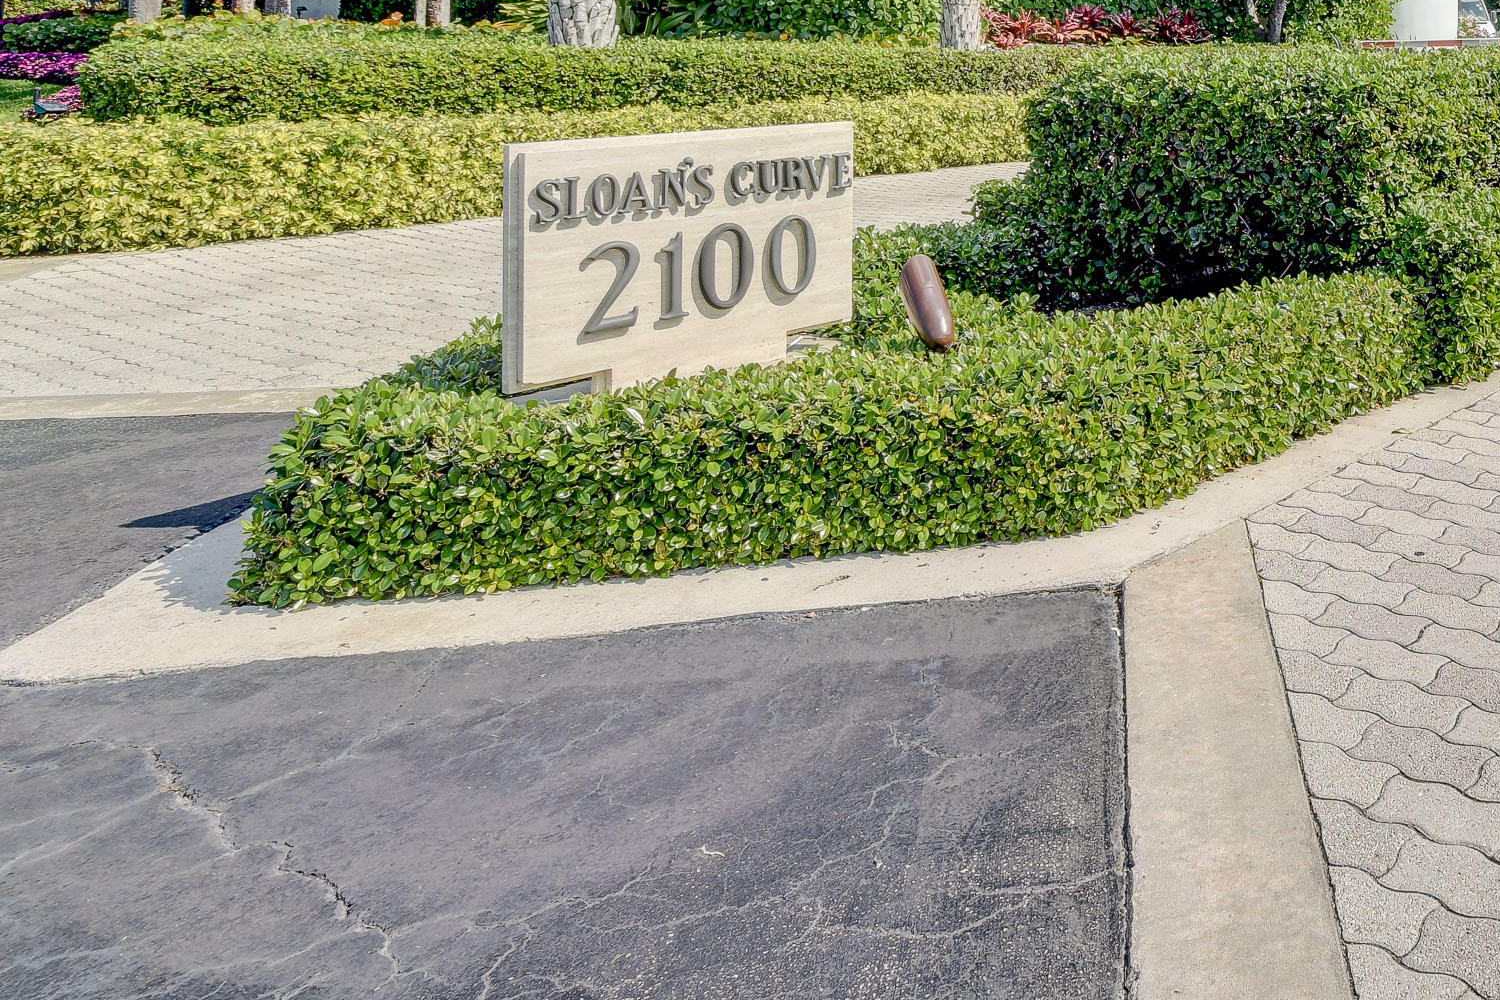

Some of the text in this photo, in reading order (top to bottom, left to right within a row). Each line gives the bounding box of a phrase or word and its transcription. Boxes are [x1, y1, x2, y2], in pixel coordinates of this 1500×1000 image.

[535, 152, 852, 224] SLOAN'S CURVE
[578, 214, 817, 335] 2100
